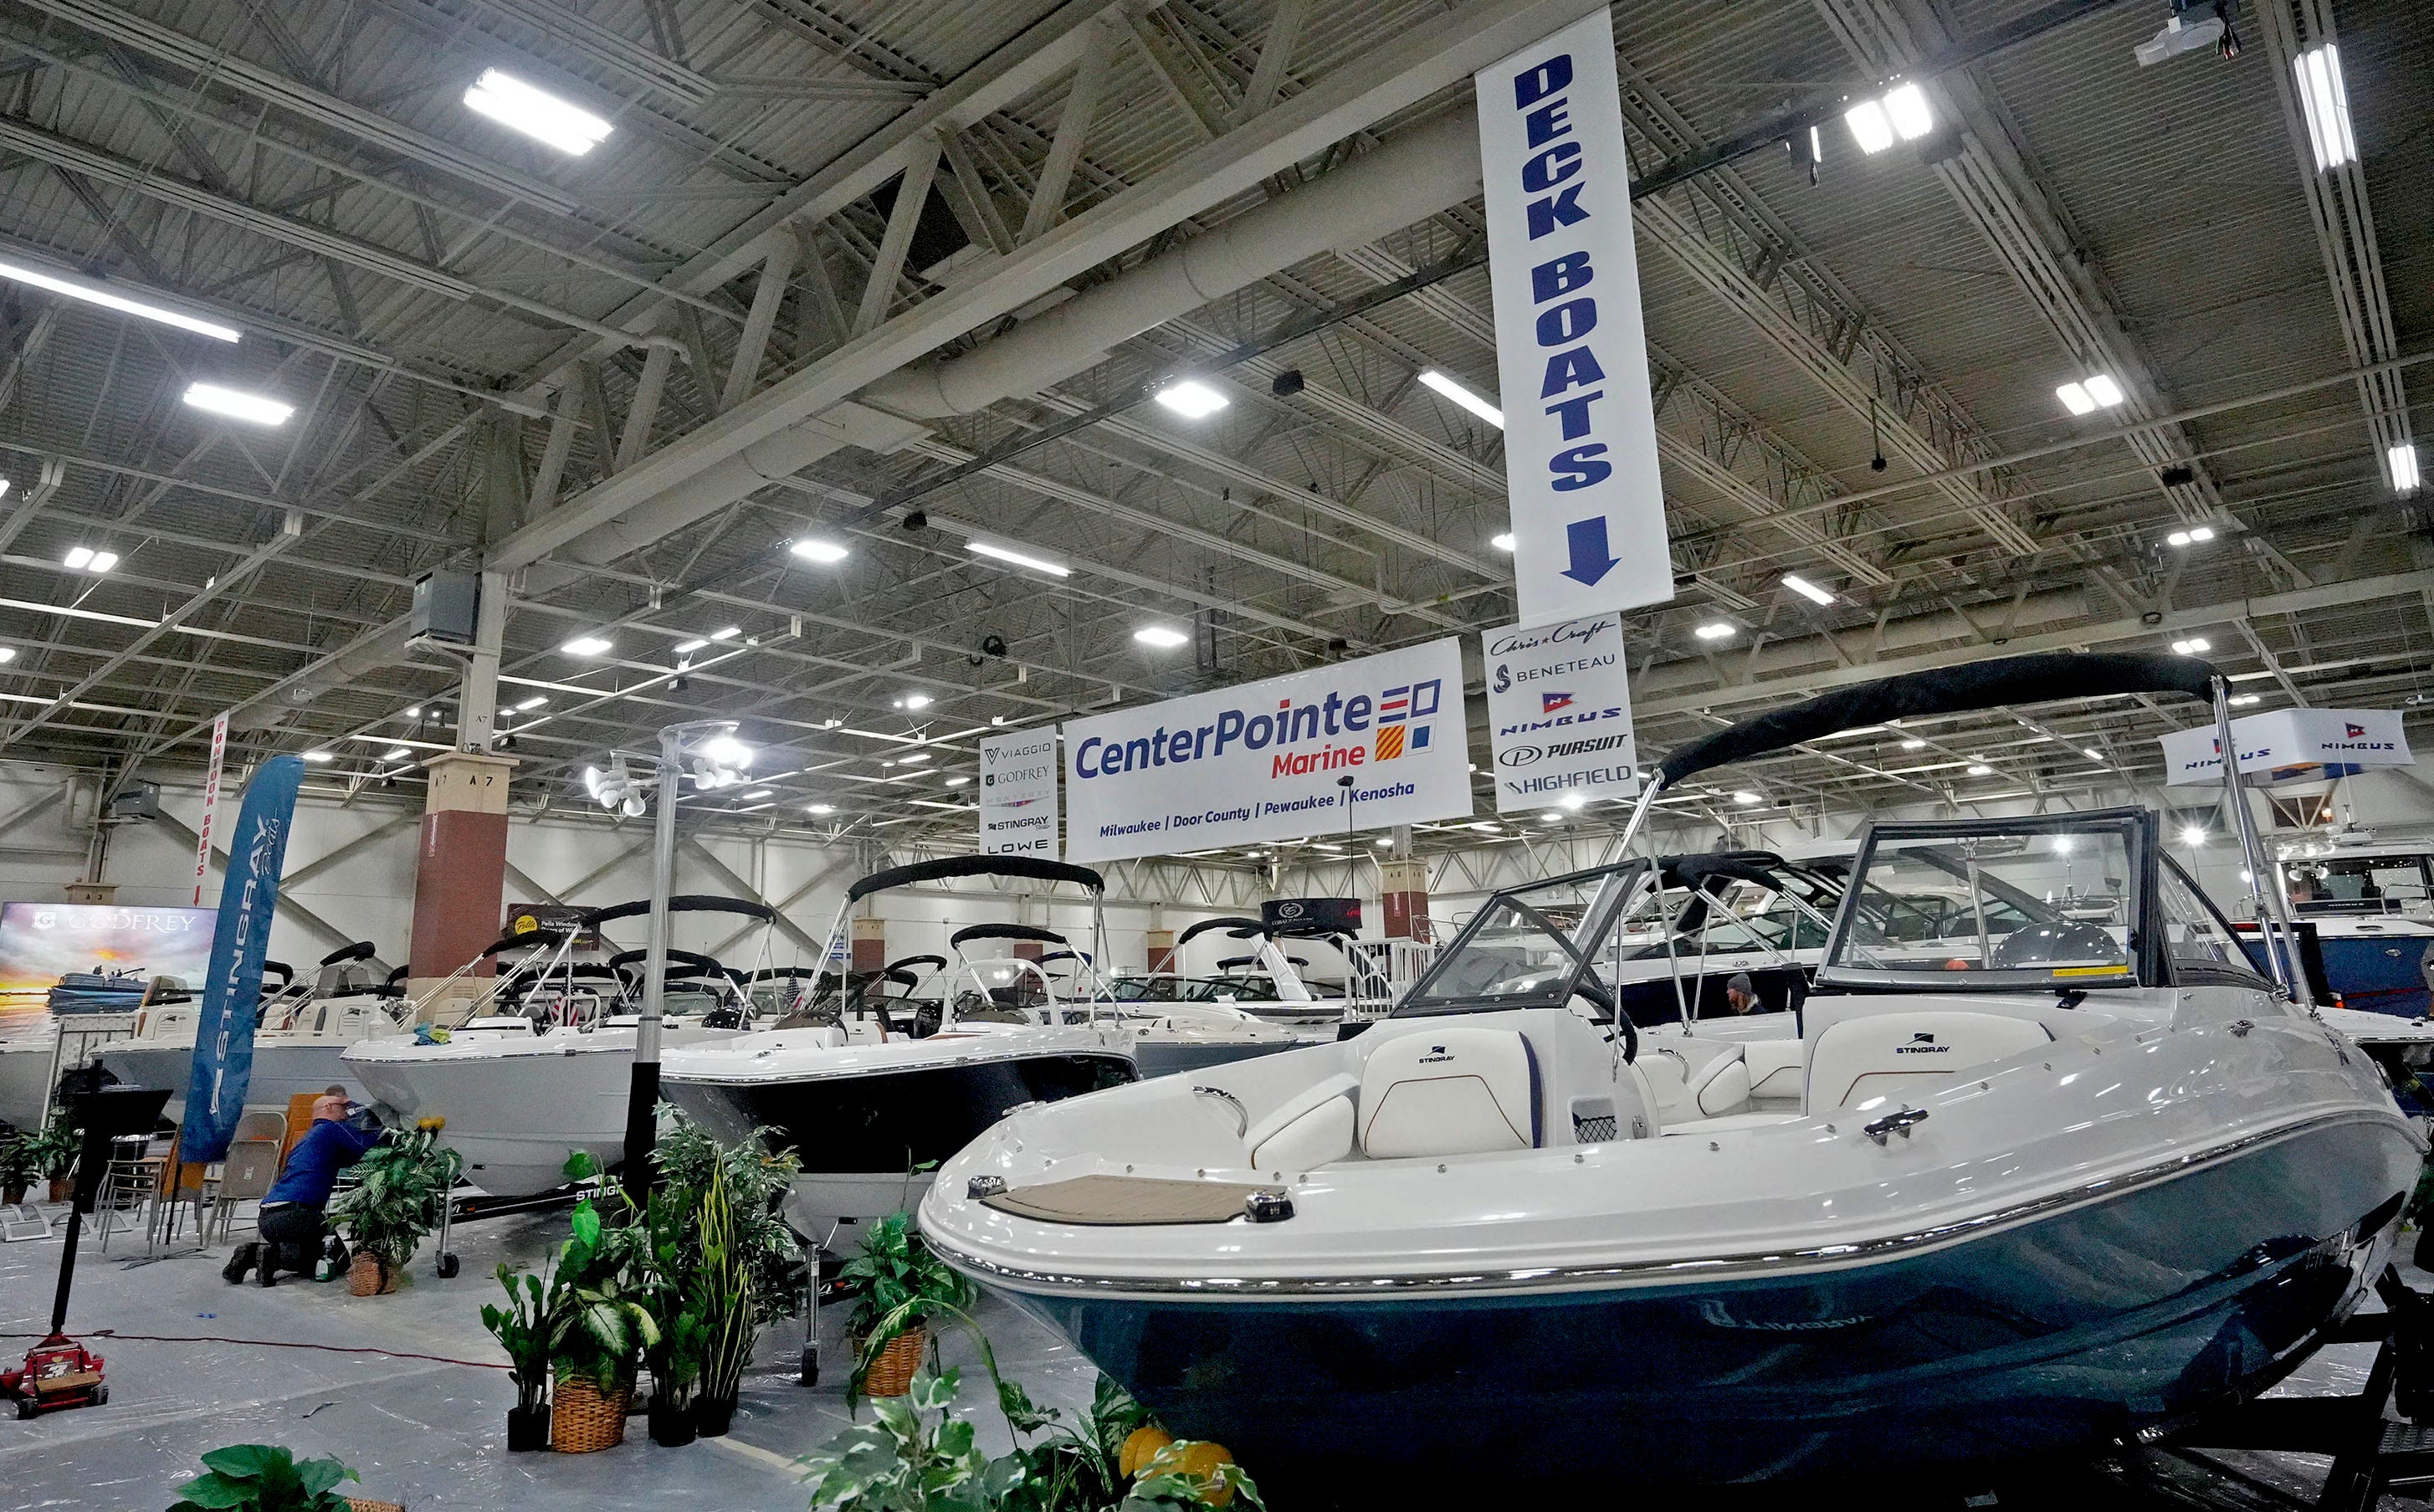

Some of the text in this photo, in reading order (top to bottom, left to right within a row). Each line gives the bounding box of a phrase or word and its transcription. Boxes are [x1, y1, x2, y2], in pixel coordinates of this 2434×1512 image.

[1514, 54, 1612, 492] DECK BOATS
[1490, 621, 1617, 656] Chris Craft
[1517, 653, 1616, 683] BENETEAU
[1500, 707, 1622, 736] NIMBUS
[1076, 690, 1372, 780] CenterPointe
[1546, 734, 1627, 758] PURSUIT
[2321, 742, 2395, 751] NIMBUS
[1002, 742, 1051, 759] VIAGGIO
[1271, 744, 1366, 779] Marine
[2185, 748, 2272, 770] NIMUS
[997, 765, 1050, 785] GODFREY
[1524, 766, 1632, 793] HIGHFIELD
[197, 720, 225, 877] PONTOON BOATS
[1099, 818, 1161, 838] Milwaukee
[1173, 813, 1202, 828] Door
[1205, 806, 1250, 823] County
[1264, 794, 1335, 815] Pewaukee
[1350, 782, 1415, 803] Kenosha
[997, 815, 1049, 830] STINGRAY
[987, 838, 1048, 854] LOWE
[68, 912, 197, 935] GODFREY
[215, 813, 268, 1062] STINGRAY
[1418, 1055, 1456, 1064] STINGRAY
[1895, 1046, 1950, 1054] STINGRAY
